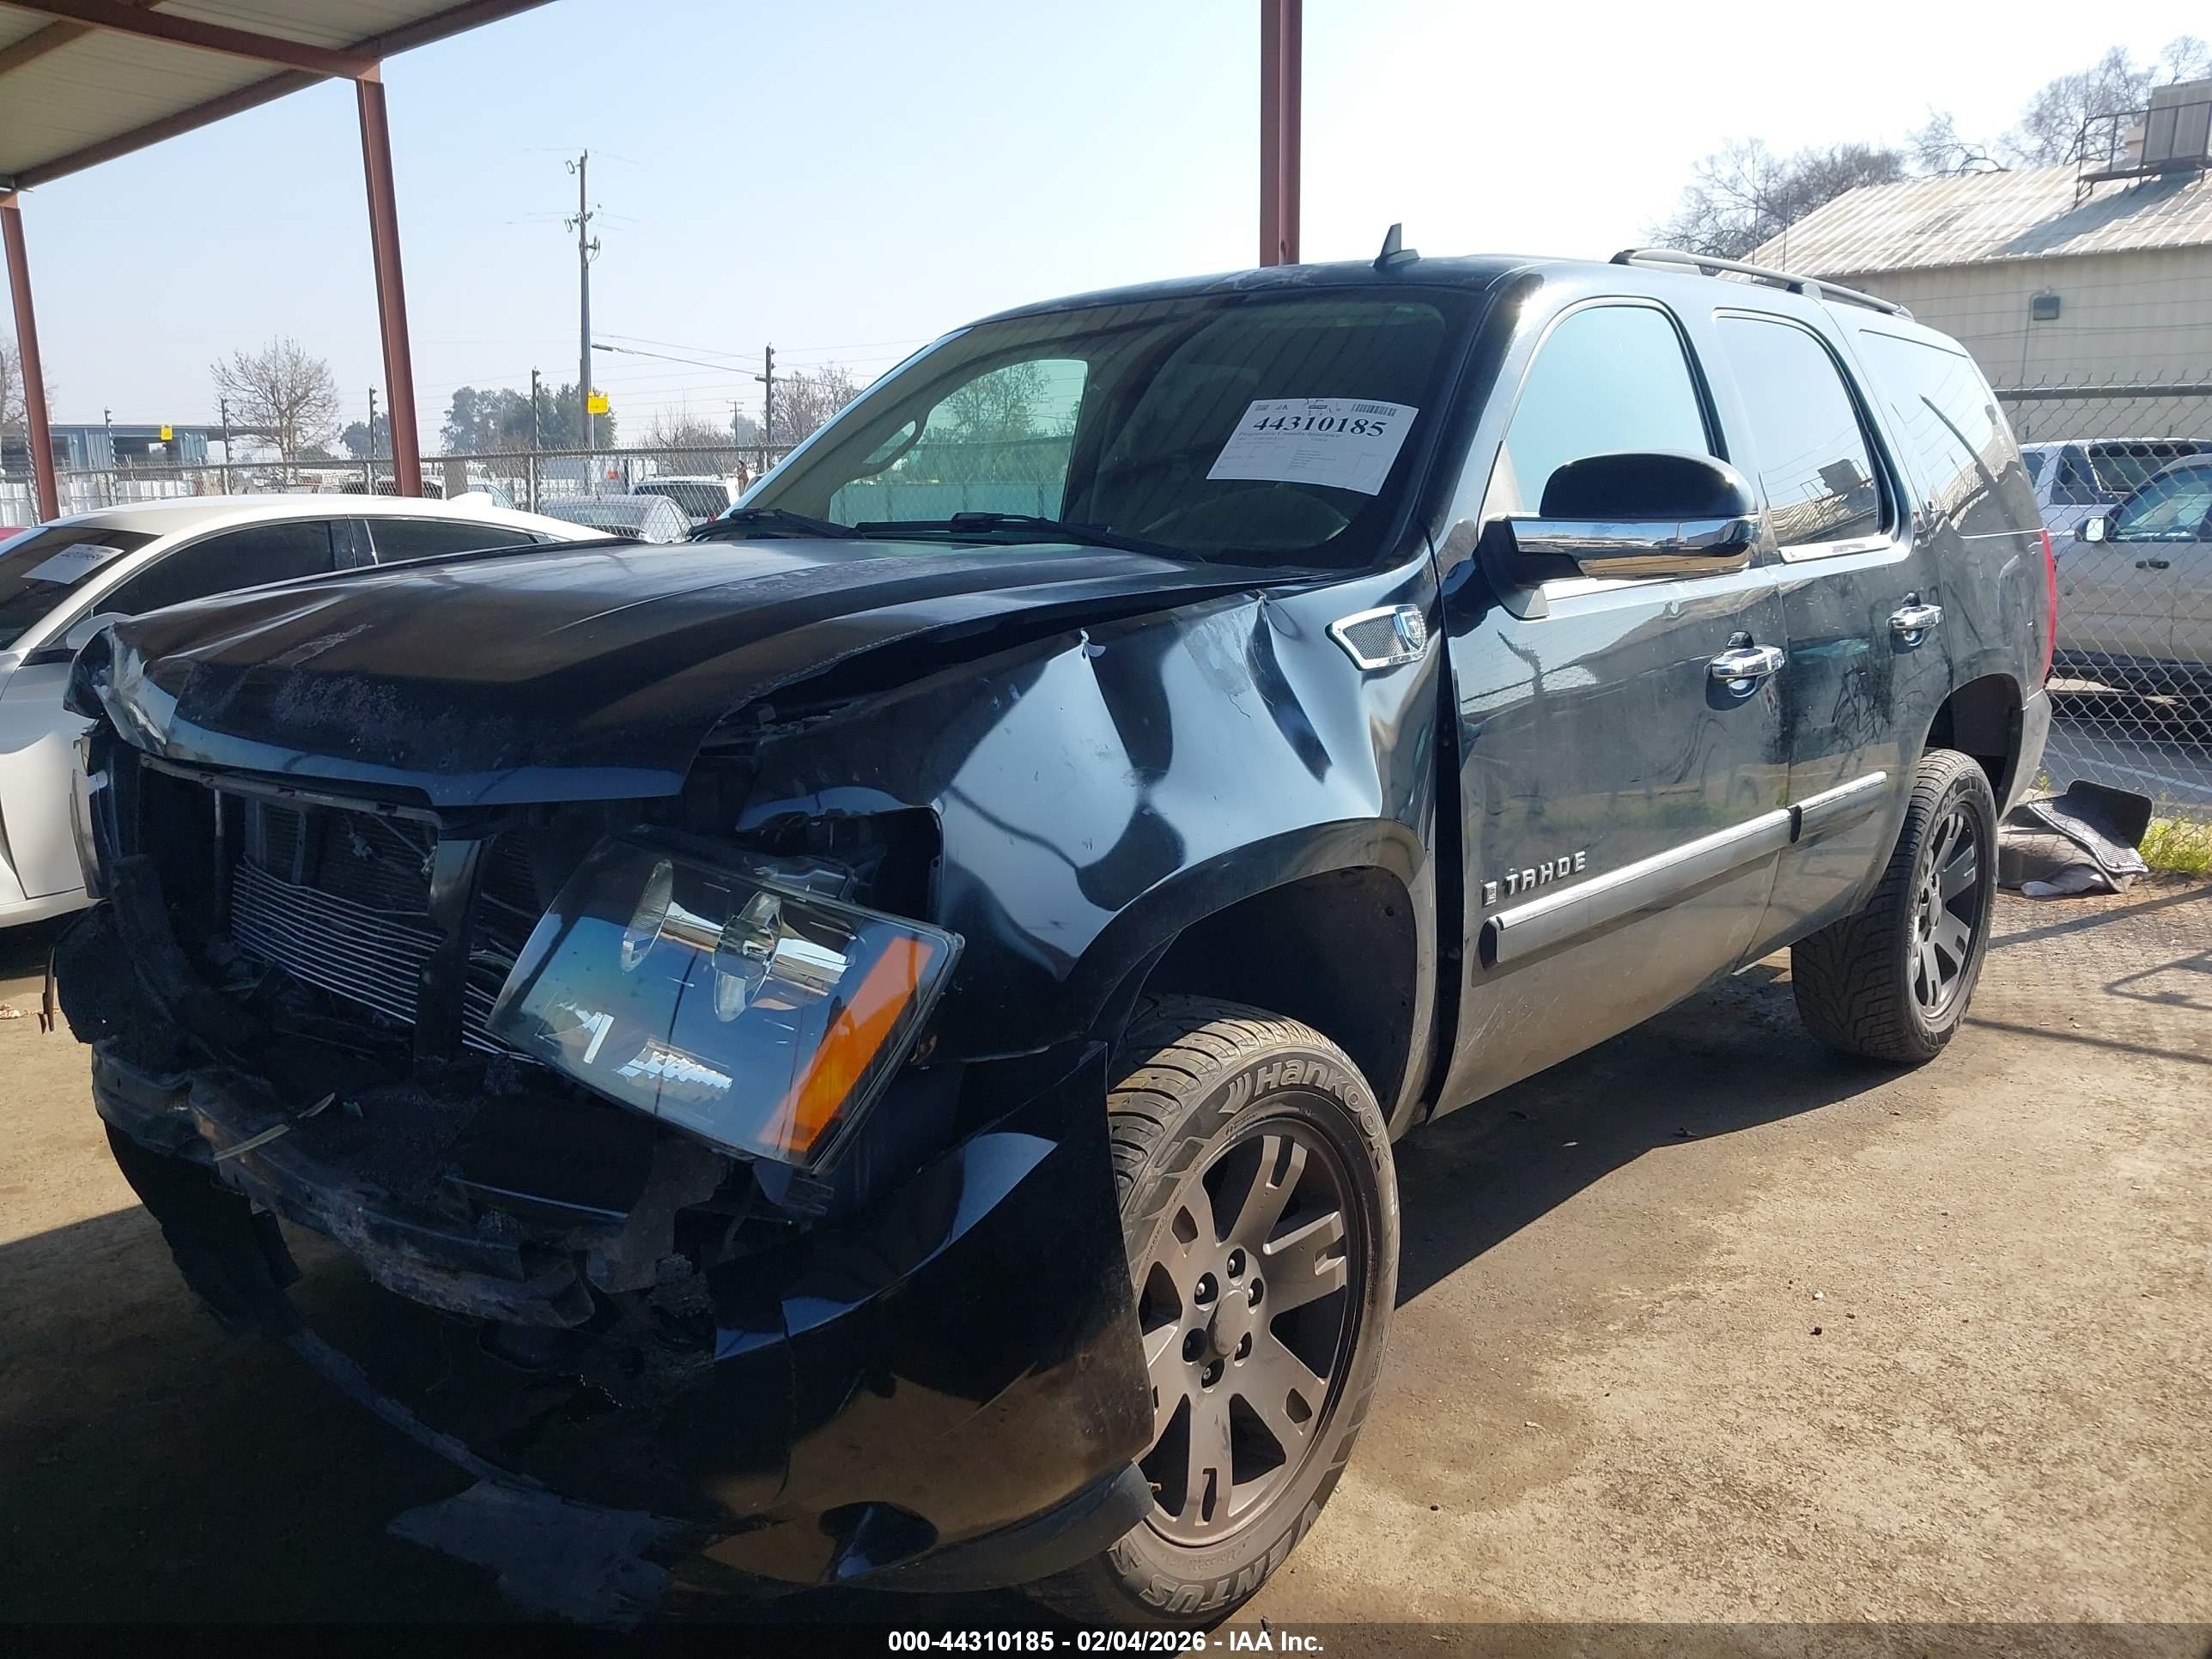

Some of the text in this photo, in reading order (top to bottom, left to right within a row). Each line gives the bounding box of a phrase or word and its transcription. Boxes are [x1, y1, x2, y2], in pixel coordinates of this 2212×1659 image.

[1253, 416, 1388, 437] 44310185
[1505, 850, 1586, 896] TAHOE
[1254, 1059, 1390, 1172] Hankook
